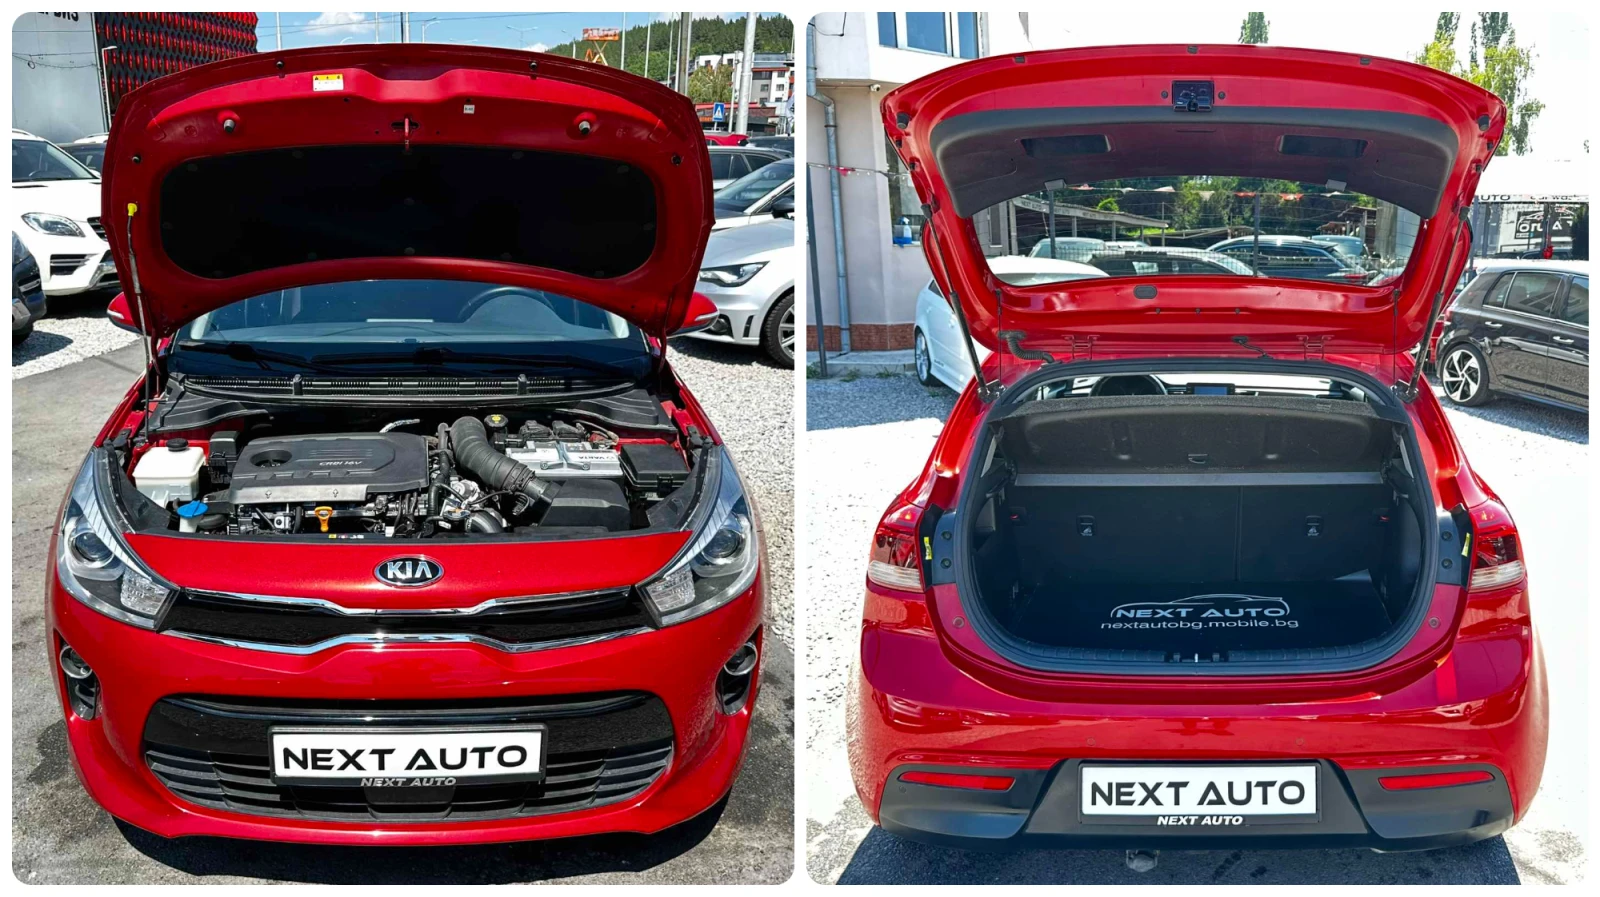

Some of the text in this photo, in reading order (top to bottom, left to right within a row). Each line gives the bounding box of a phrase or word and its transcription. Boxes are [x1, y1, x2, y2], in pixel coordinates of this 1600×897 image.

[387, 561, 433, 579] KIA
[1116, 608, 1286, 618] NEXT AUTO
[1101, 619, 1299, 630] nextautobg.mobile.bg
[283, 745, 527, 771] NEXT AUTO
[360, 777, 457, 787] NEXT AUTO
[1091, 780, 1305, 806] NEXT AUTO
[1157, 816, 1244, 825] NEXT AUTO
